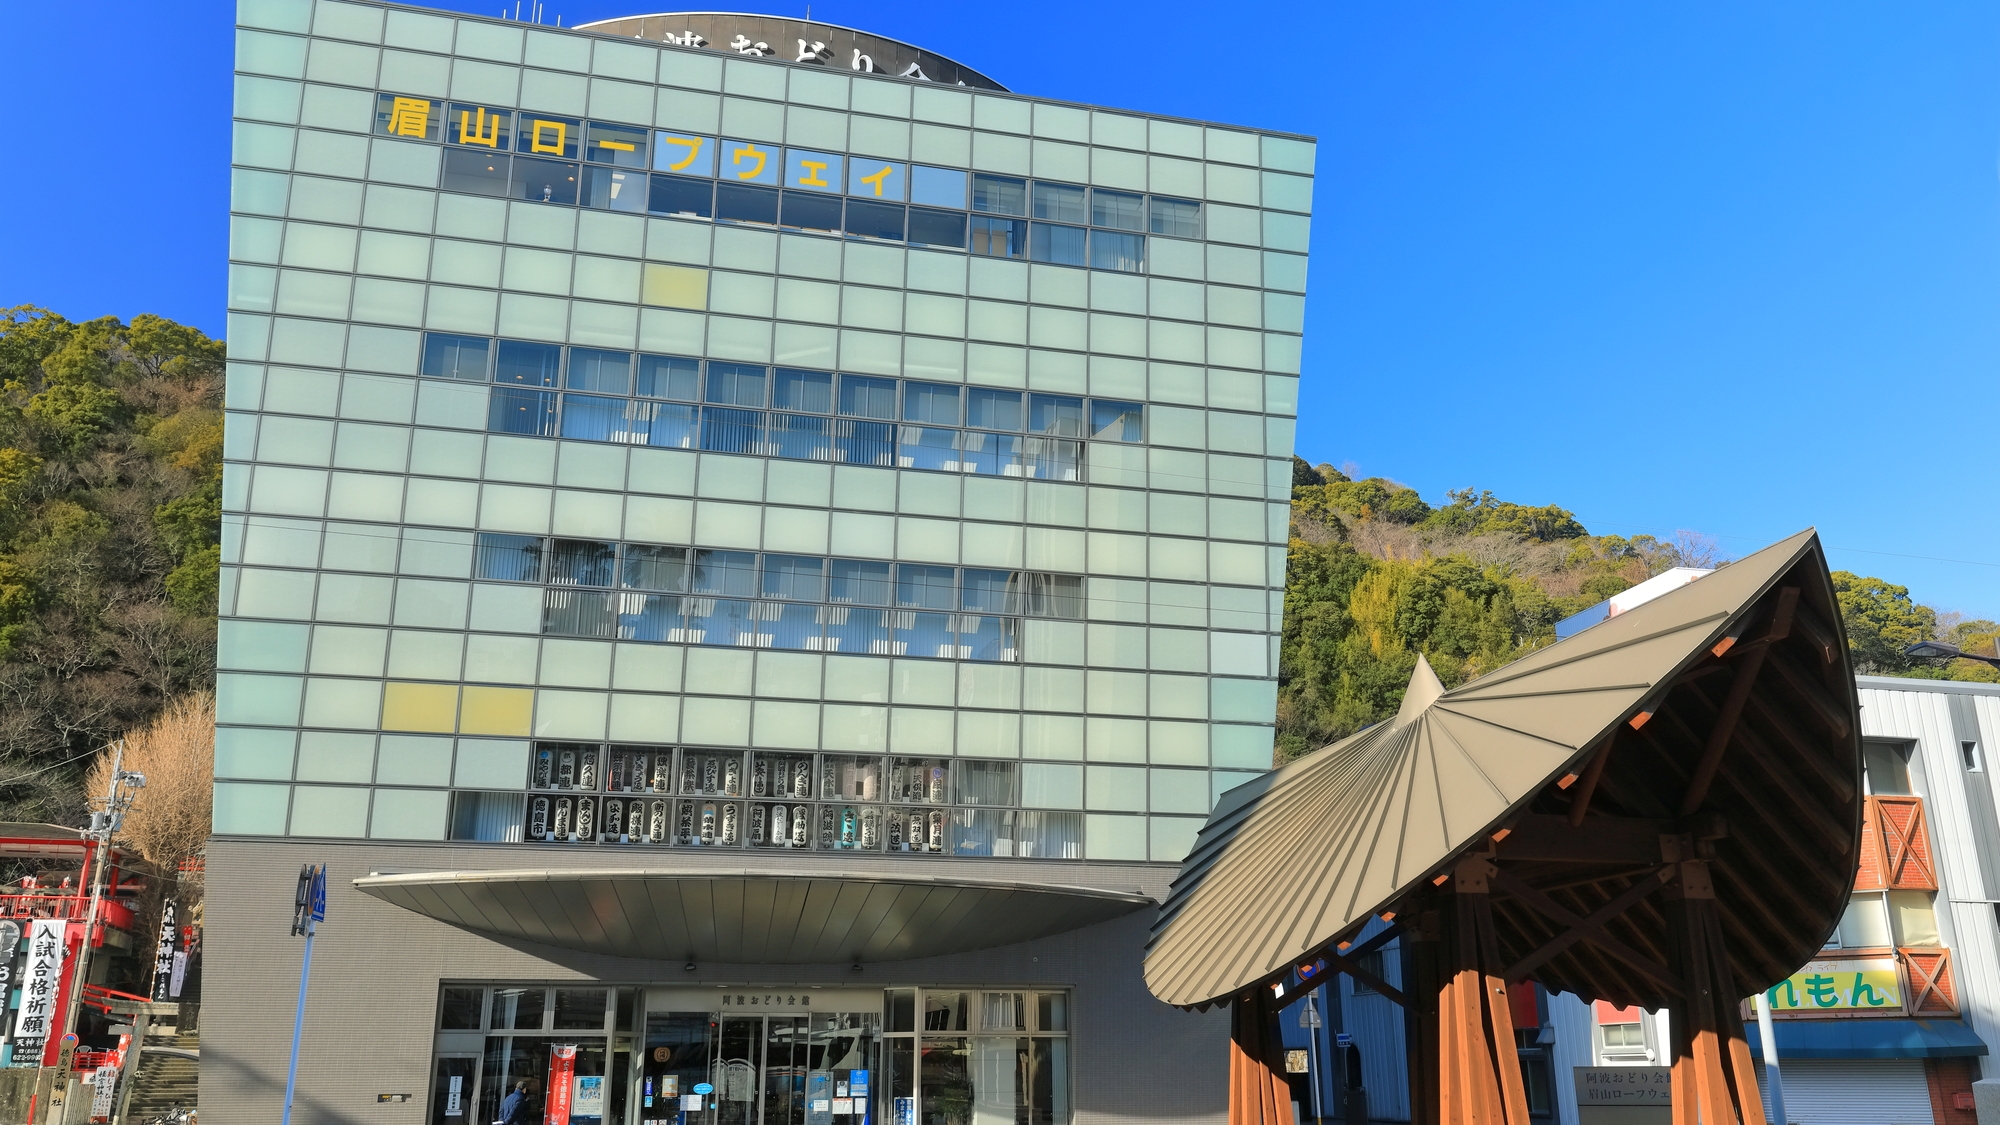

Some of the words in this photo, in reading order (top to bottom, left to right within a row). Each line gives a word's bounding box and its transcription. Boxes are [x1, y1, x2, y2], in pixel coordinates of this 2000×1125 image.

[387, 96, 893, 197] 眉山ロープウェイ
[533, 799, 546, 834] 徳島市
[21, 924, 57, 1033] 入試合格祈願
[722, 995, 810, 1006] 阿波おどり会館
[51, 1048, 70, 1107] 徳島天神社
